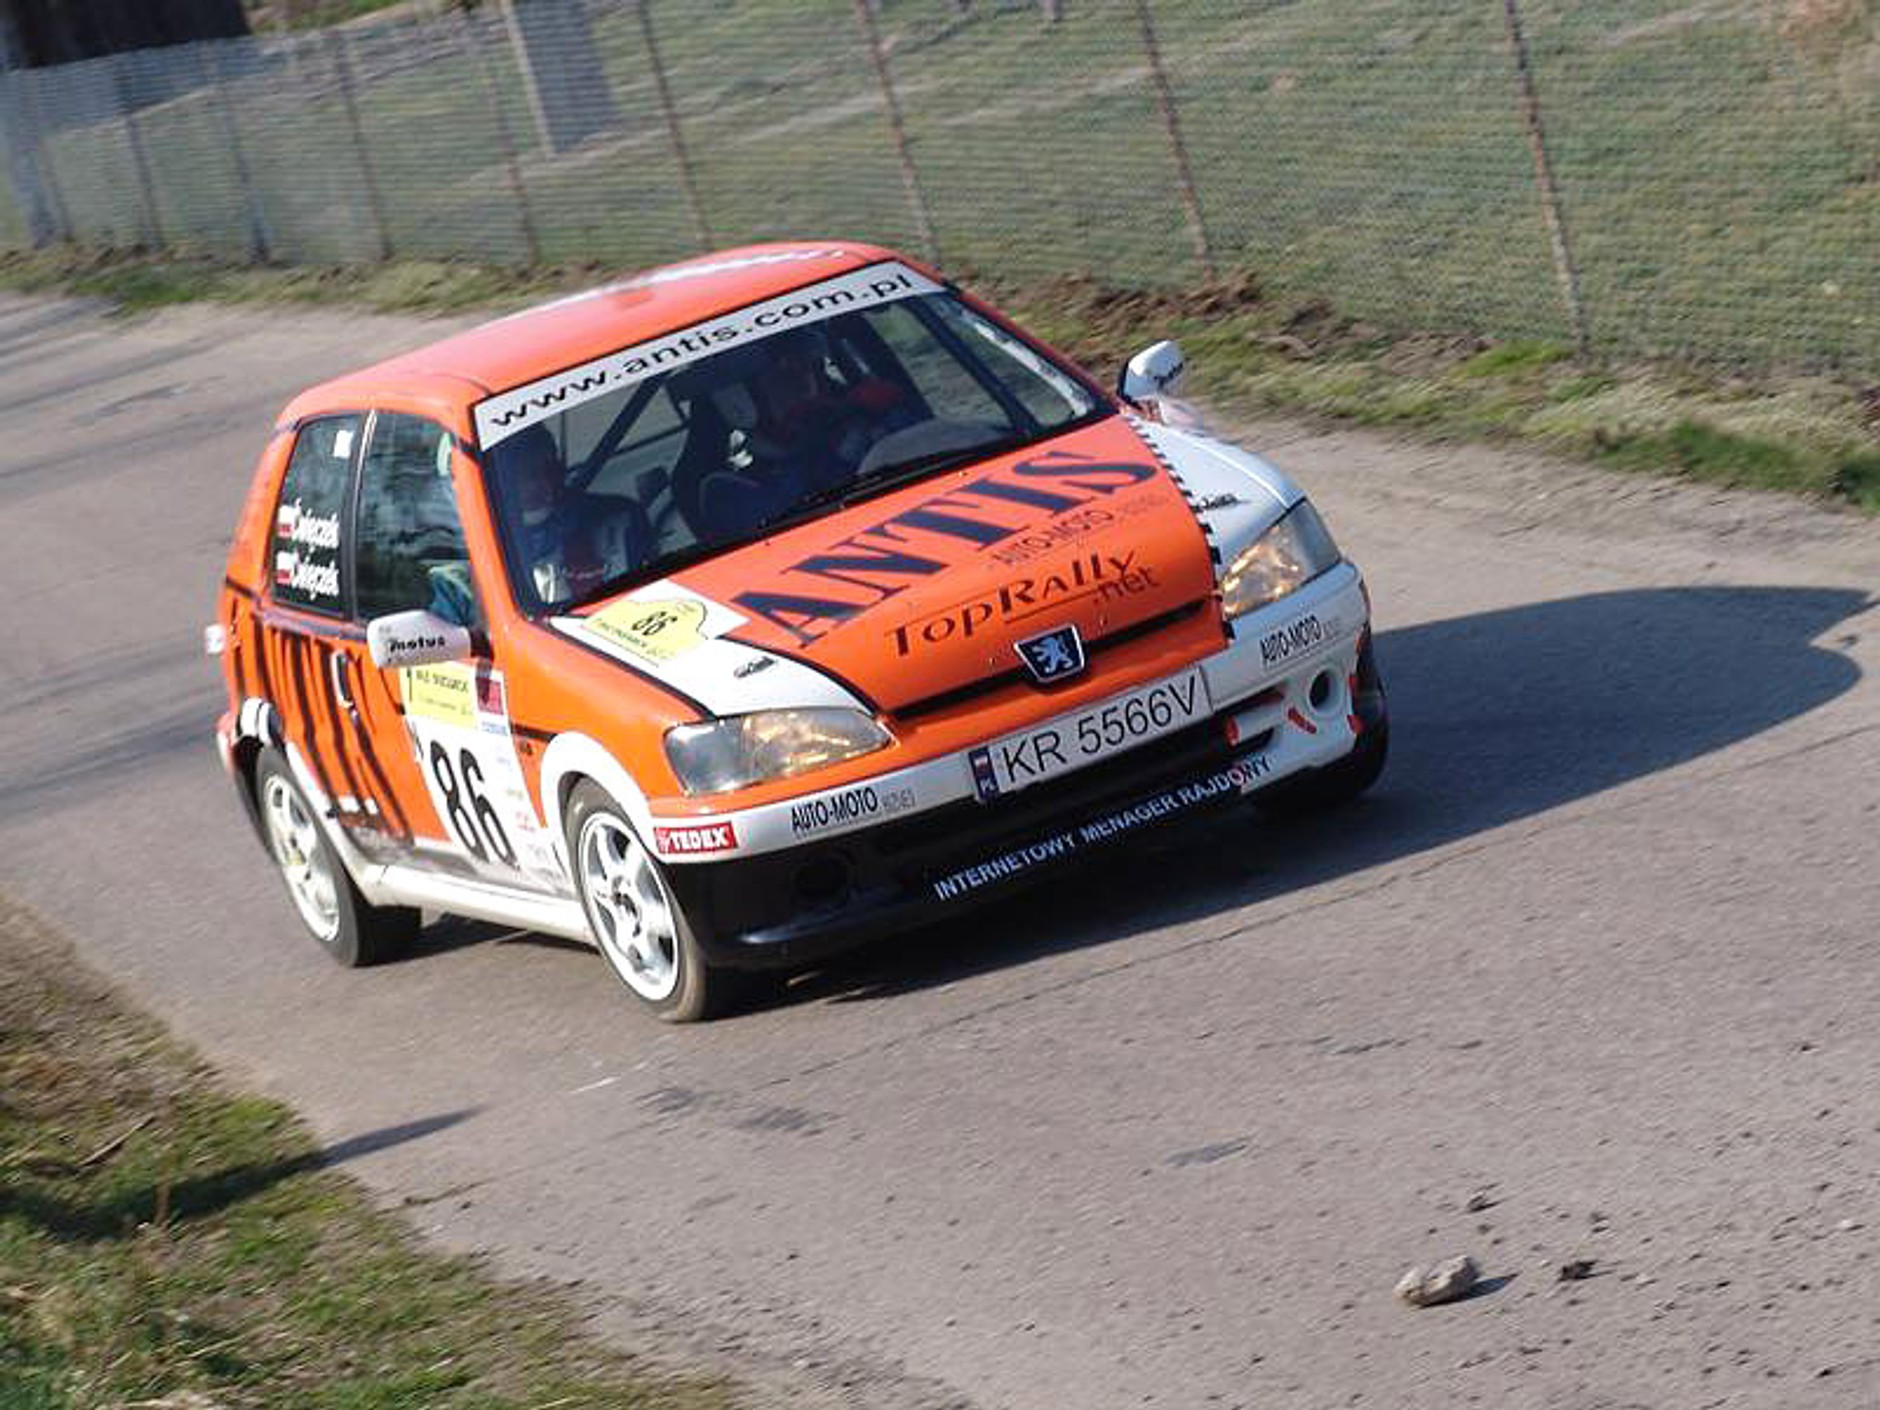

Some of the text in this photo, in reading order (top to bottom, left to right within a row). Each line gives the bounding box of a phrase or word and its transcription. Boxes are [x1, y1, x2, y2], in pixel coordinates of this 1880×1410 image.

[489, 274, 914, 428] www.antis.com.pl
[730, 450, 1158, 648] ANTIS
[631, 610, 679, 636] 86
[1259, 614, 1322, 662] AUTO-MOTO
[1001, 675, 1196, 783] KR 5566V
[429, 740, 521, 872] 86
[790, 786, 878, 833] AUTO-MOTO
[934, 753, 1273, 900] INTERNETOWY MENAGER RAJDOWY
